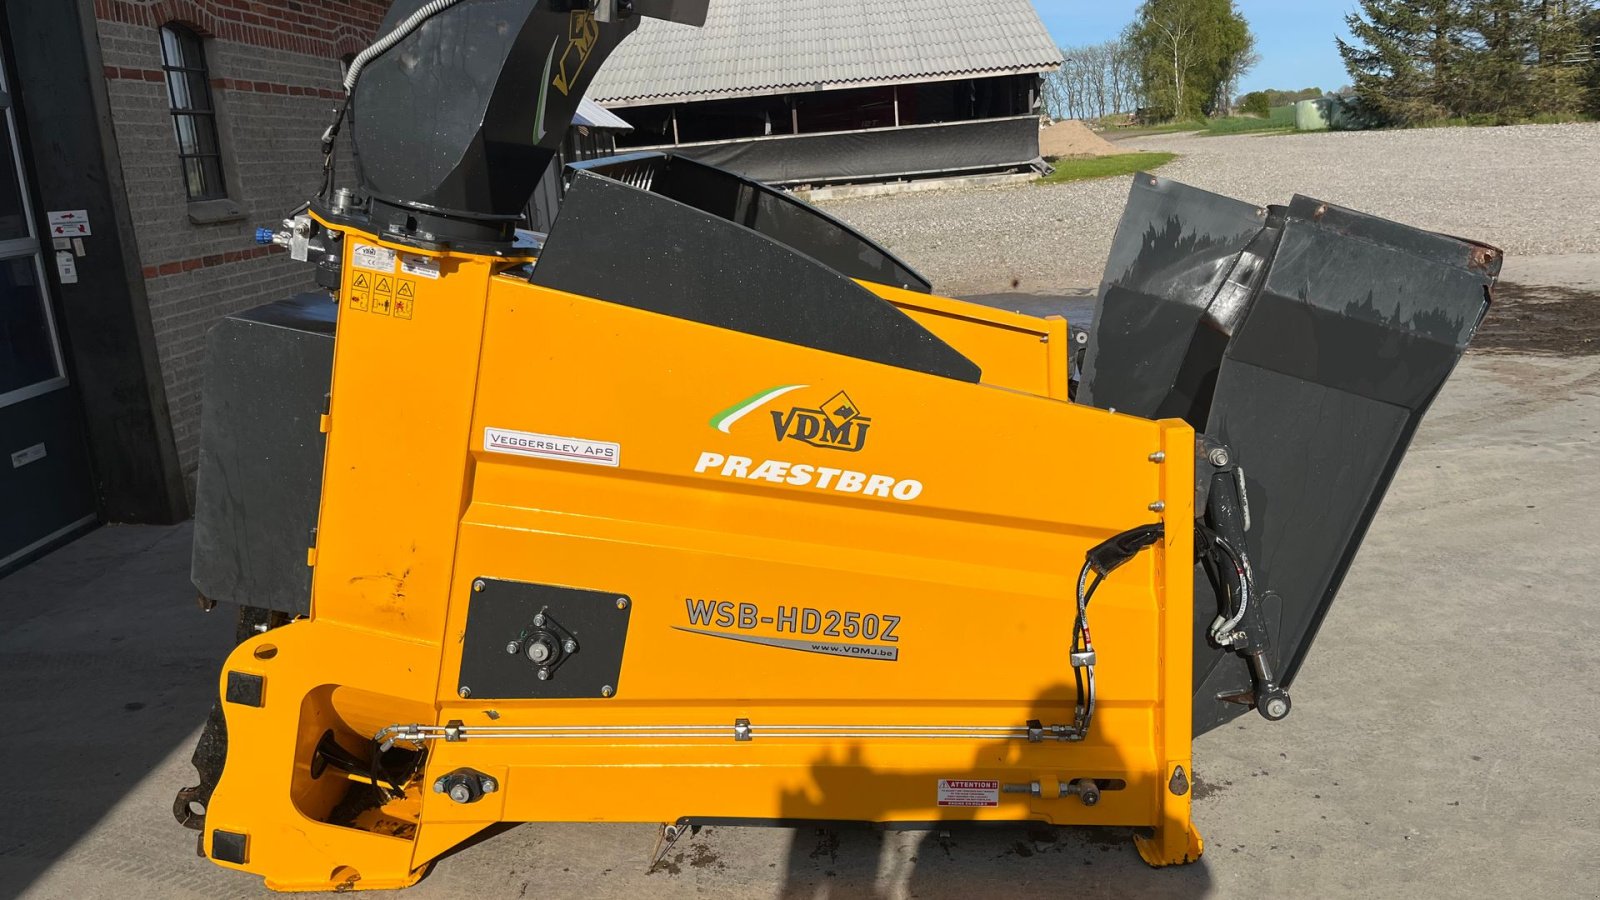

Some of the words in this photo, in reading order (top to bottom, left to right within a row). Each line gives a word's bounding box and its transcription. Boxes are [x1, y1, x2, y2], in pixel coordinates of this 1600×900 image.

[490, 433, 579, 453] VEGGERSLEV
[770, 406, 872, 452] VDMJ
[693, 451, 923, 501] PRÆSTBRO
[685, 598, 901, 642] WSB-HD250Z
